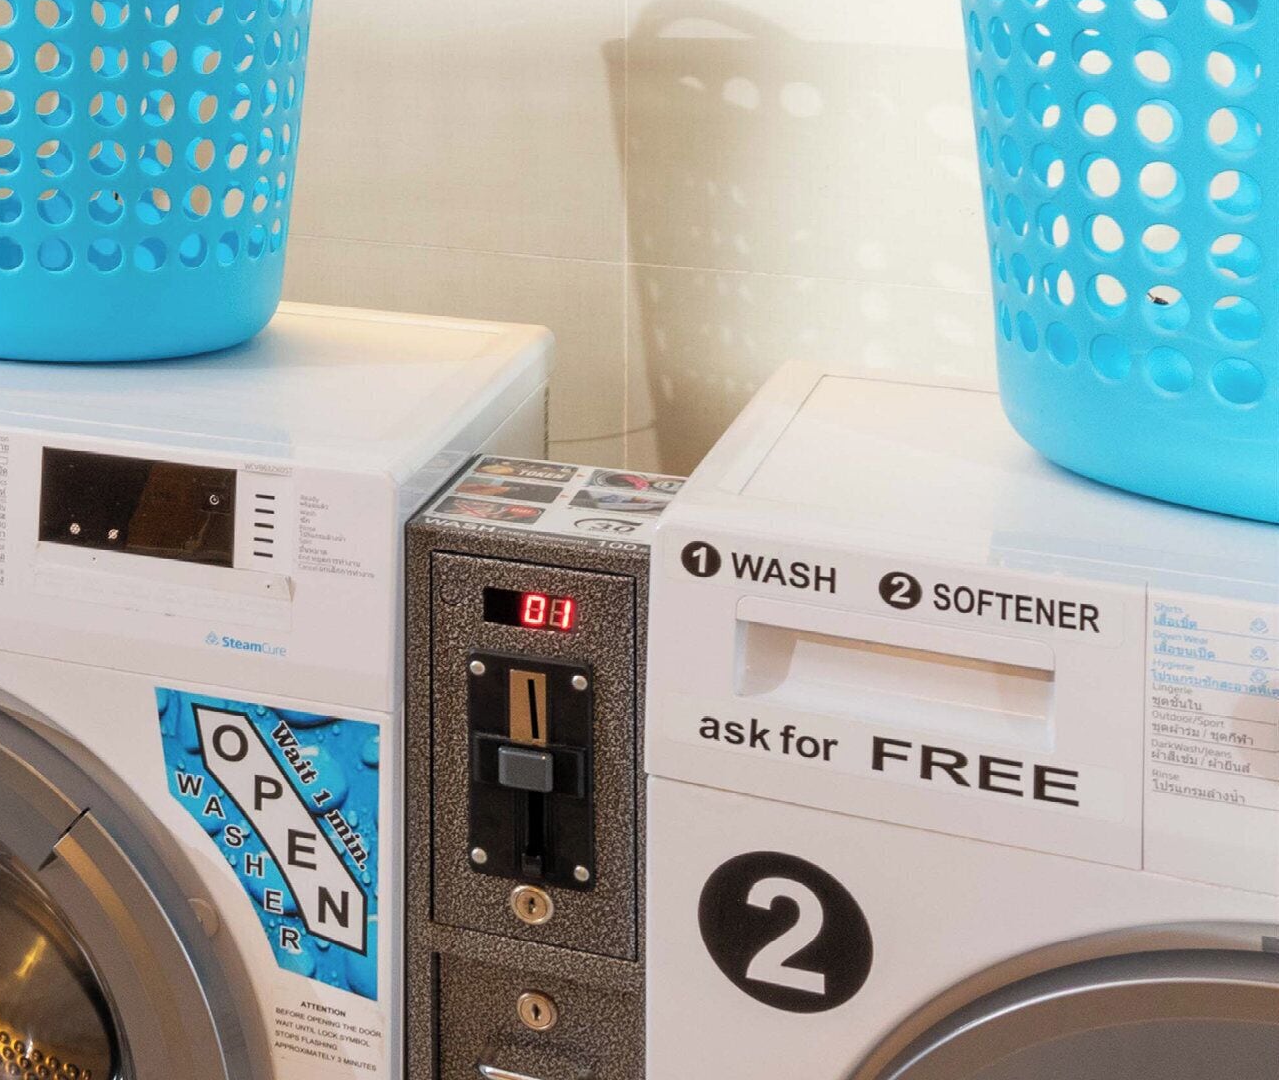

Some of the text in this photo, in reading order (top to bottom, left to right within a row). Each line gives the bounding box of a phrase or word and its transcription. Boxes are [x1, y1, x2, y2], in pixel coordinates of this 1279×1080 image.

[517, 467, 566, 481] TOKEN
[424, 517, 638, 552] WASH 100
[732, 552, 837, 594] WASH
[933, 583, 1100, 633] SOFTENER
[524, 594, 571, 629] 01
[222, 636, 287, 656] SteamCure
[699, 716, 1080, 807] ask for FREE
[1151, 768, 1180, 782] Rinse
[272, 722, 367, 870] Wait 1 min.
[212, 724, 349, 928] OPEN
[177, 773, 300, 950] WASHER
[746, 876, 827, 997] 2
[275, 1007, 305, 1020] BEFORE
[307, 1015, 341, 1028] OPENING
[343, 1023, 357, 1033] THE
[301, 1001, 346, 1017] ATTENTION
[275, 1018, 370, 1047] WAIT UNTIL LOCK SYMBOL
[275, 1029, 338, 1051] STOPS FLASHING
[274, 1041, 335, 1060] APPROXIMATELY
[343, 1058, 377, 1072] MINUTES
